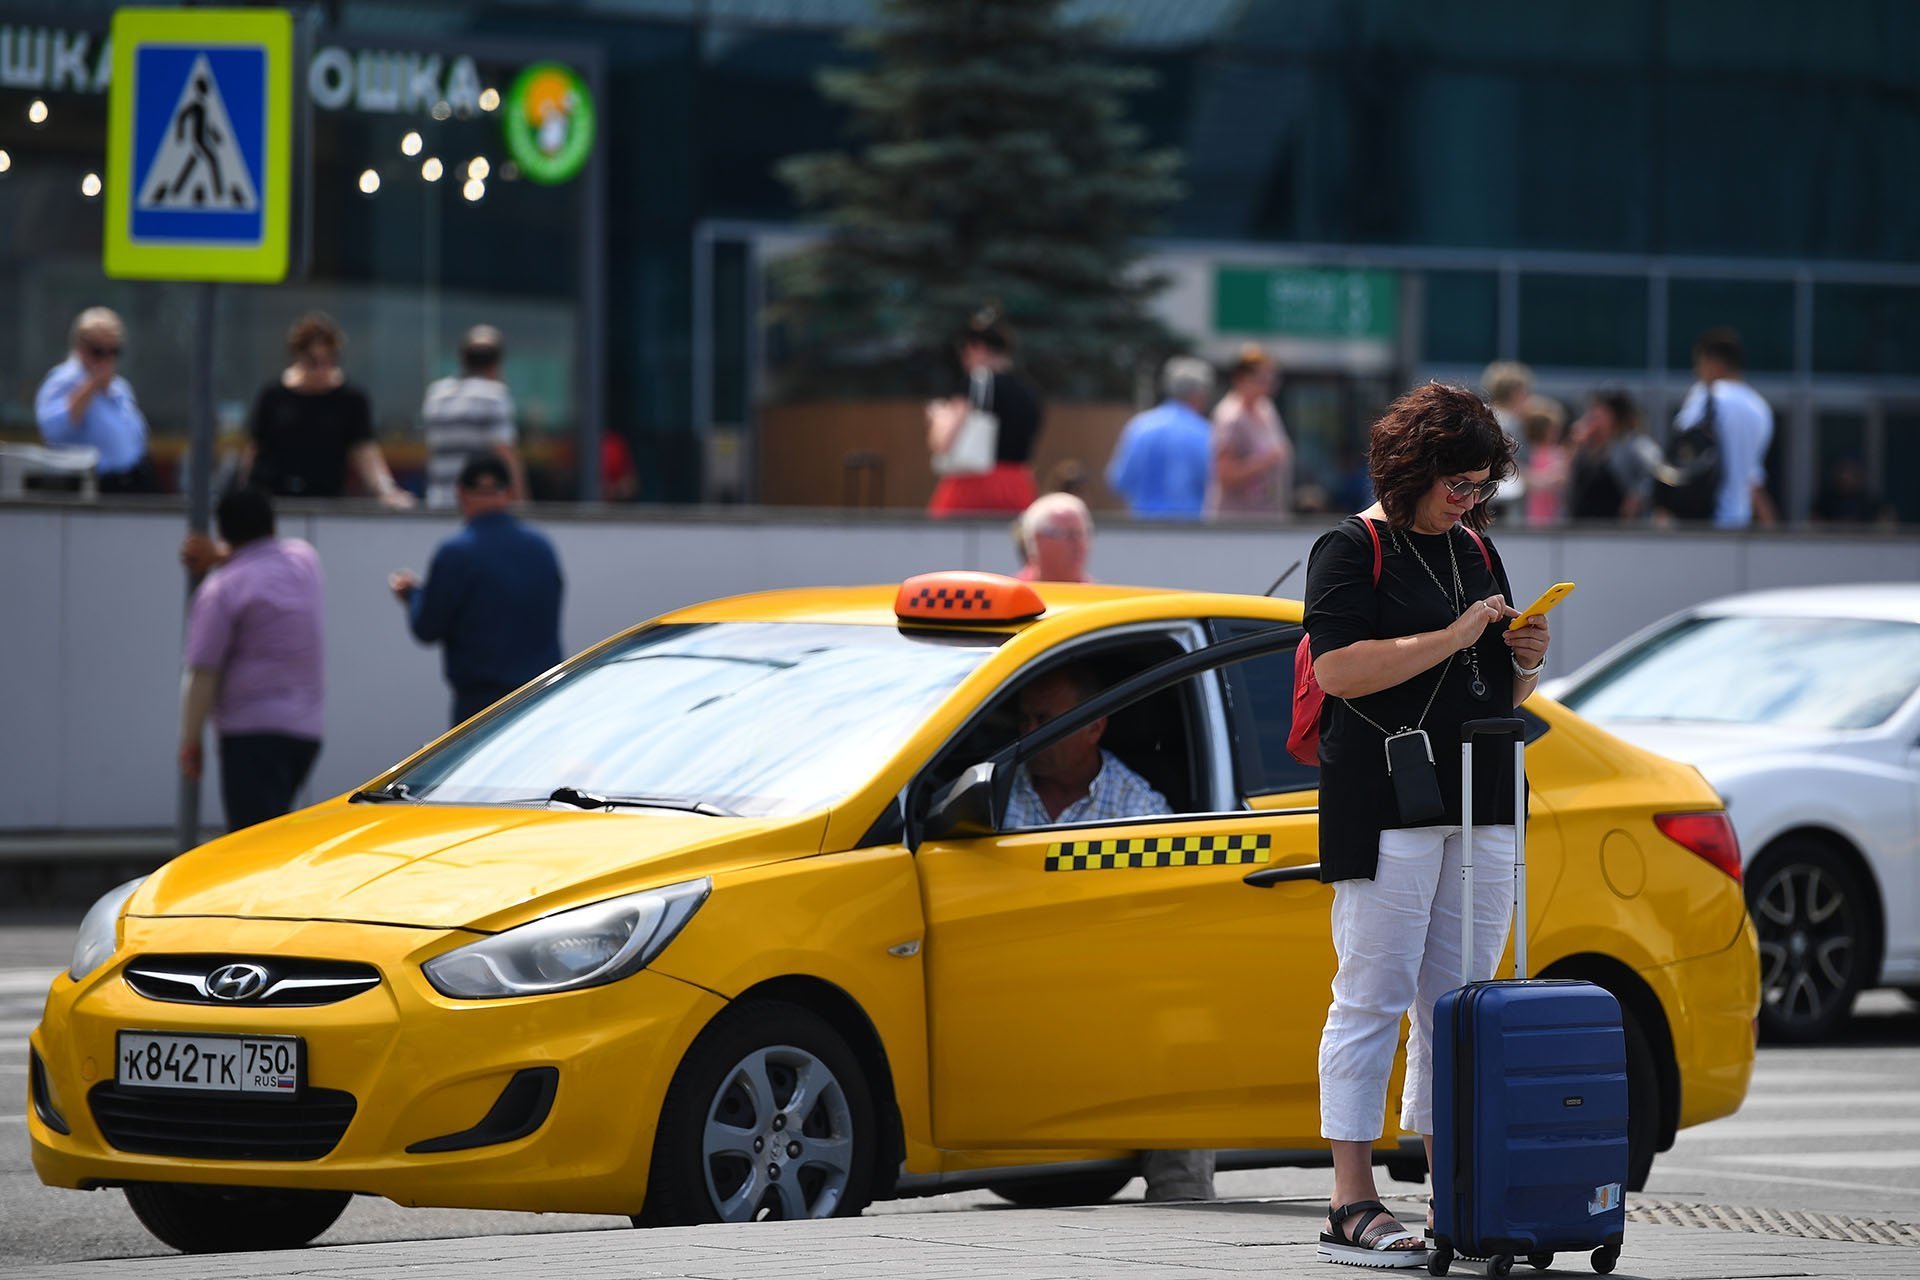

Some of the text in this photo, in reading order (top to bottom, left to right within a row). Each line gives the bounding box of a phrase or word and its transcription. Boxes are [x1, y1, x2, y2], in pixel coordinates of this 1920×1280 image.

[128, 1041, 289, 1084] К842ТК 750
[254, 1075, 277, 1087] RUS
